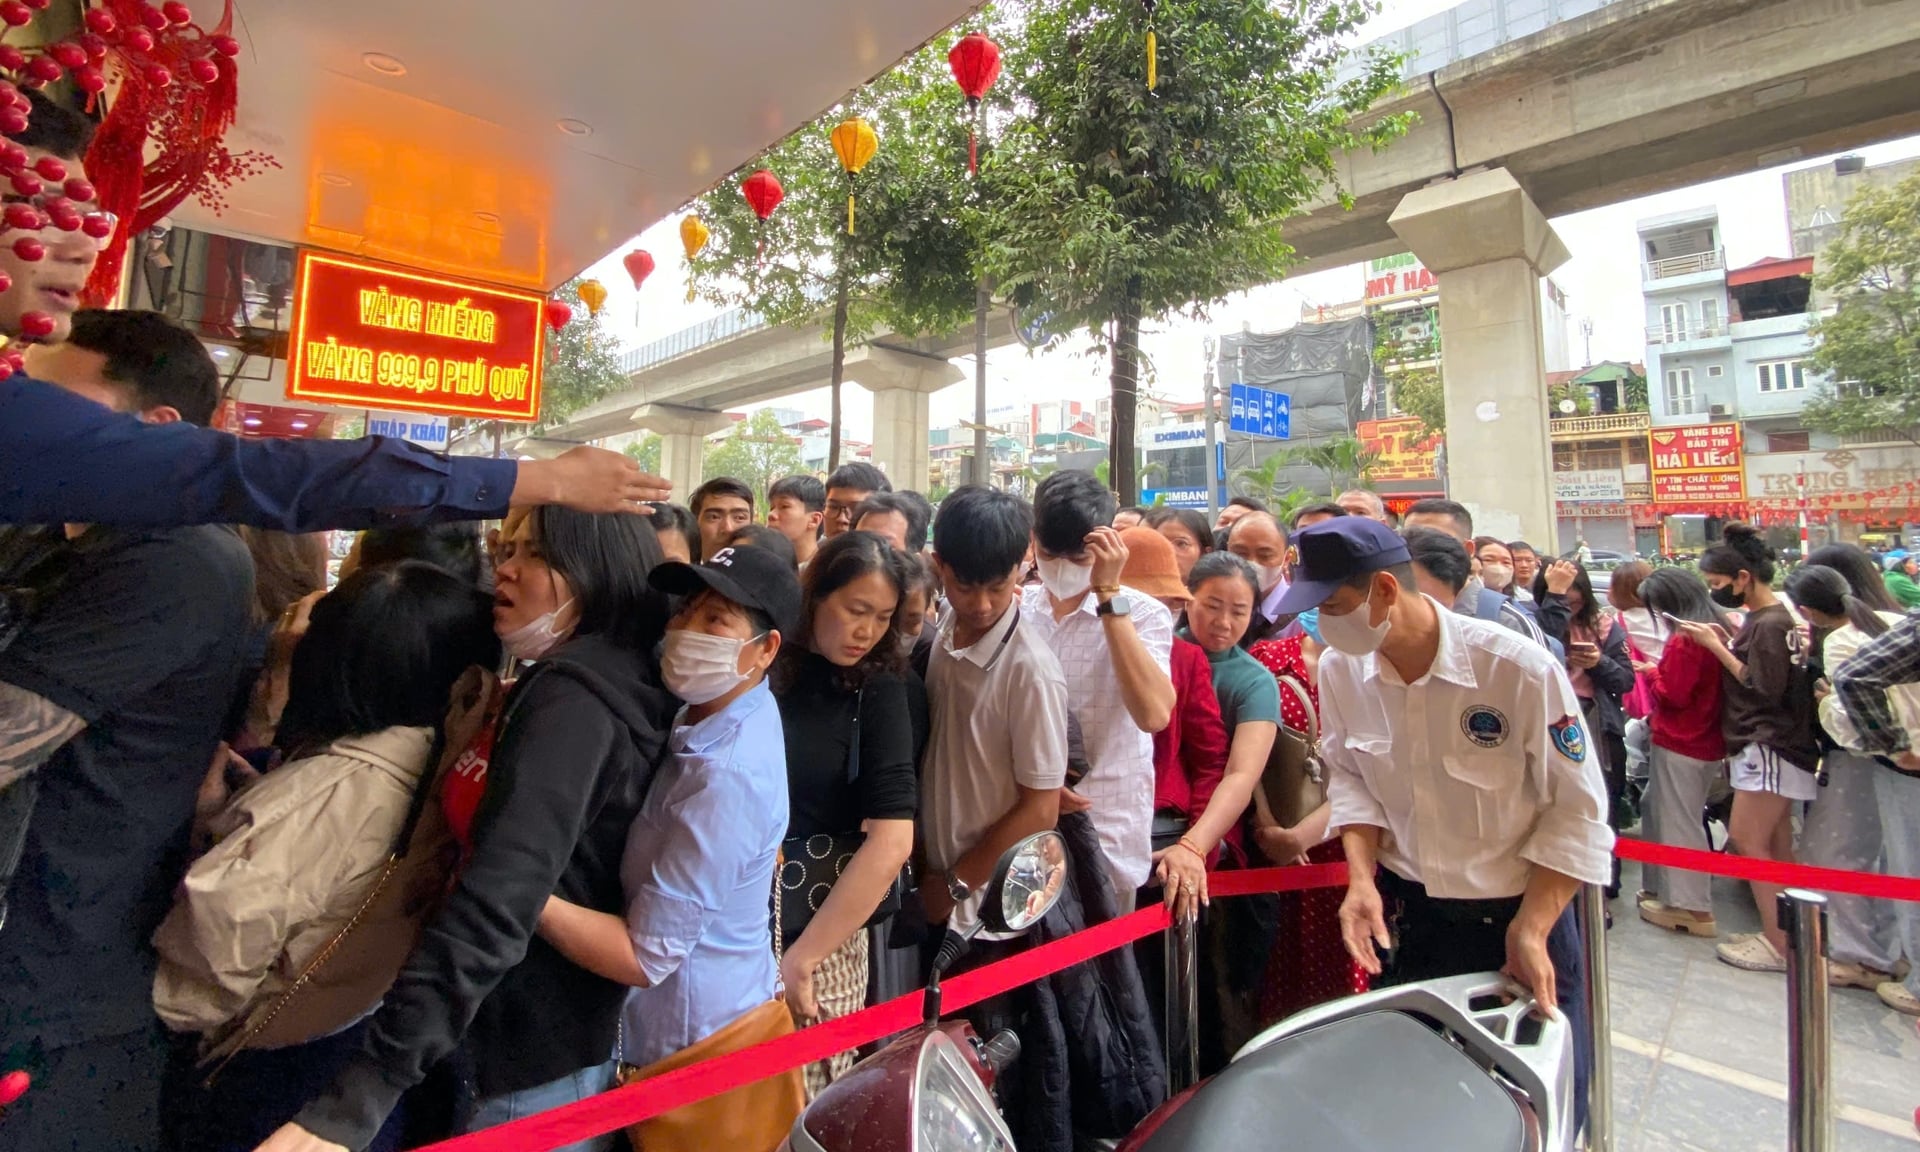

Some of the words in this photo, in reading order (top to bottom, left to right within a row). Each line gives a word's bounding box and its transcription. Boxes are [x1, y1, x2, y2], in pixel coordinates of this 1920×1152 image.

[1367, 271, 1396, 298] MỸ
[360, 286, 422, 332] VÀNG
[425, 297, 495, 343] MIẾNG
[307, 336, 374, 384] VÀNG
[377, 352, 440, 393] 999,9
[488, 363, 530, 402] QUÝ
[1154, 429, 1206, 443] EXIMBAN
[1682, 428, 1709, 437] VÀNG
[1711, 426, 1732, 437] BẠC
[1656, 448, 1688, 468] HẢI
[1693, 448, 1736, 467] LIÊN
